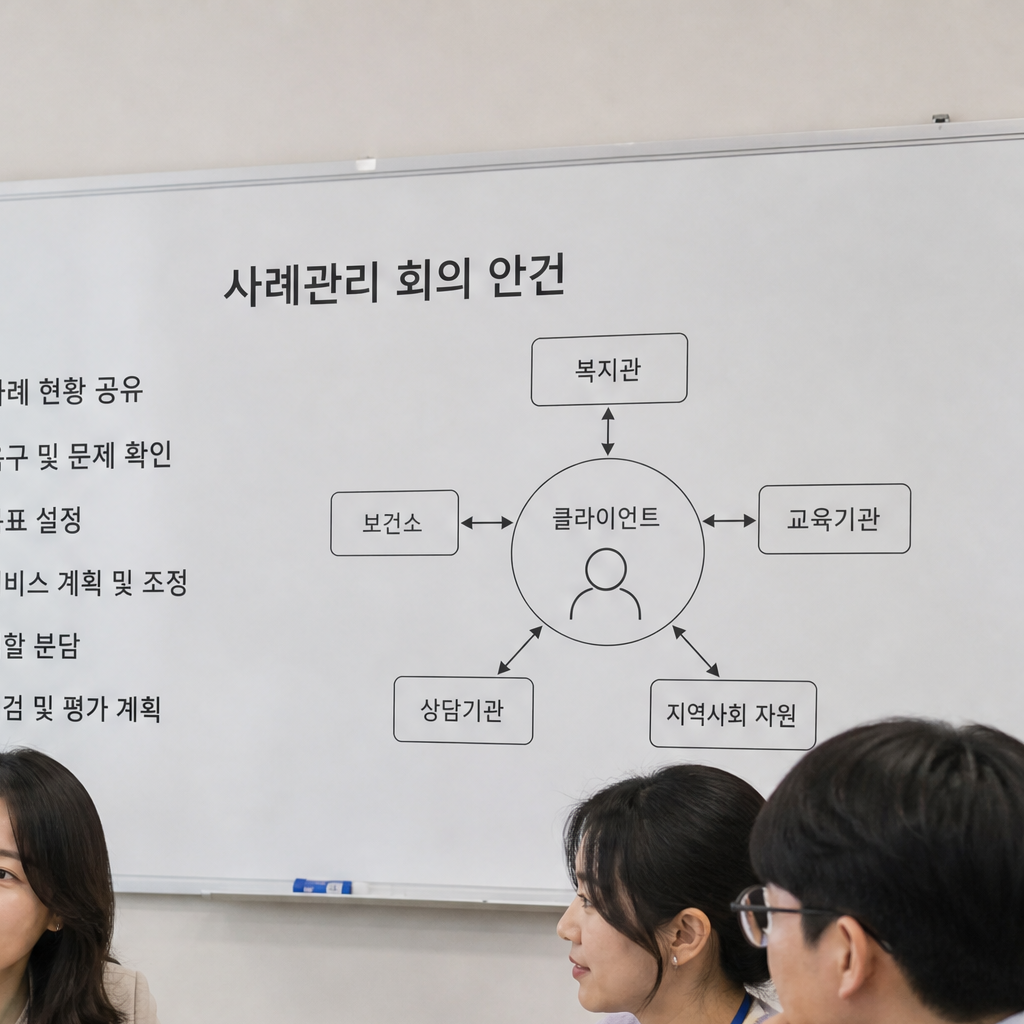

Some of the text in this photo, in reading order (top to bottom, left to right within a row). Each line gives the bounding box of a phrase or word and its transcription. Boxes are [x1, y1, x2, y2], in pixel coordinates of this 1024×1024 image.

[223, 251, 565, 308] 사례관리 회의 안건
[574, 356, 642, 384] 복지관
[38, 376, 87, 406] 현황
[94, 375, 144, 405] 공유
[38, 442, 59, 471] 및
[67, 441, 115, 470] 문제
[124, 439, 171, 470] 확인
[36, 505, 81, 535] 설정
[362, 511, 423, 535] 보건소
[552, 505, 661, 531] 클라이언트
[786, 506, 881, 533] 교육기관
[57, 569, 102, 598] 계획
[112, 569, 133, 597] 및
[142, 568, 187, 598] 조정
[33, 632, 81, 660] 분담
[33, 694, 54, 722] 및
[62, 695, 109, 723] 평가
[116, 695, 161, 724] 계획
[420, 697, 505, 723] 상담기관
[666, 701, 796, 729] 지역사회 자원
